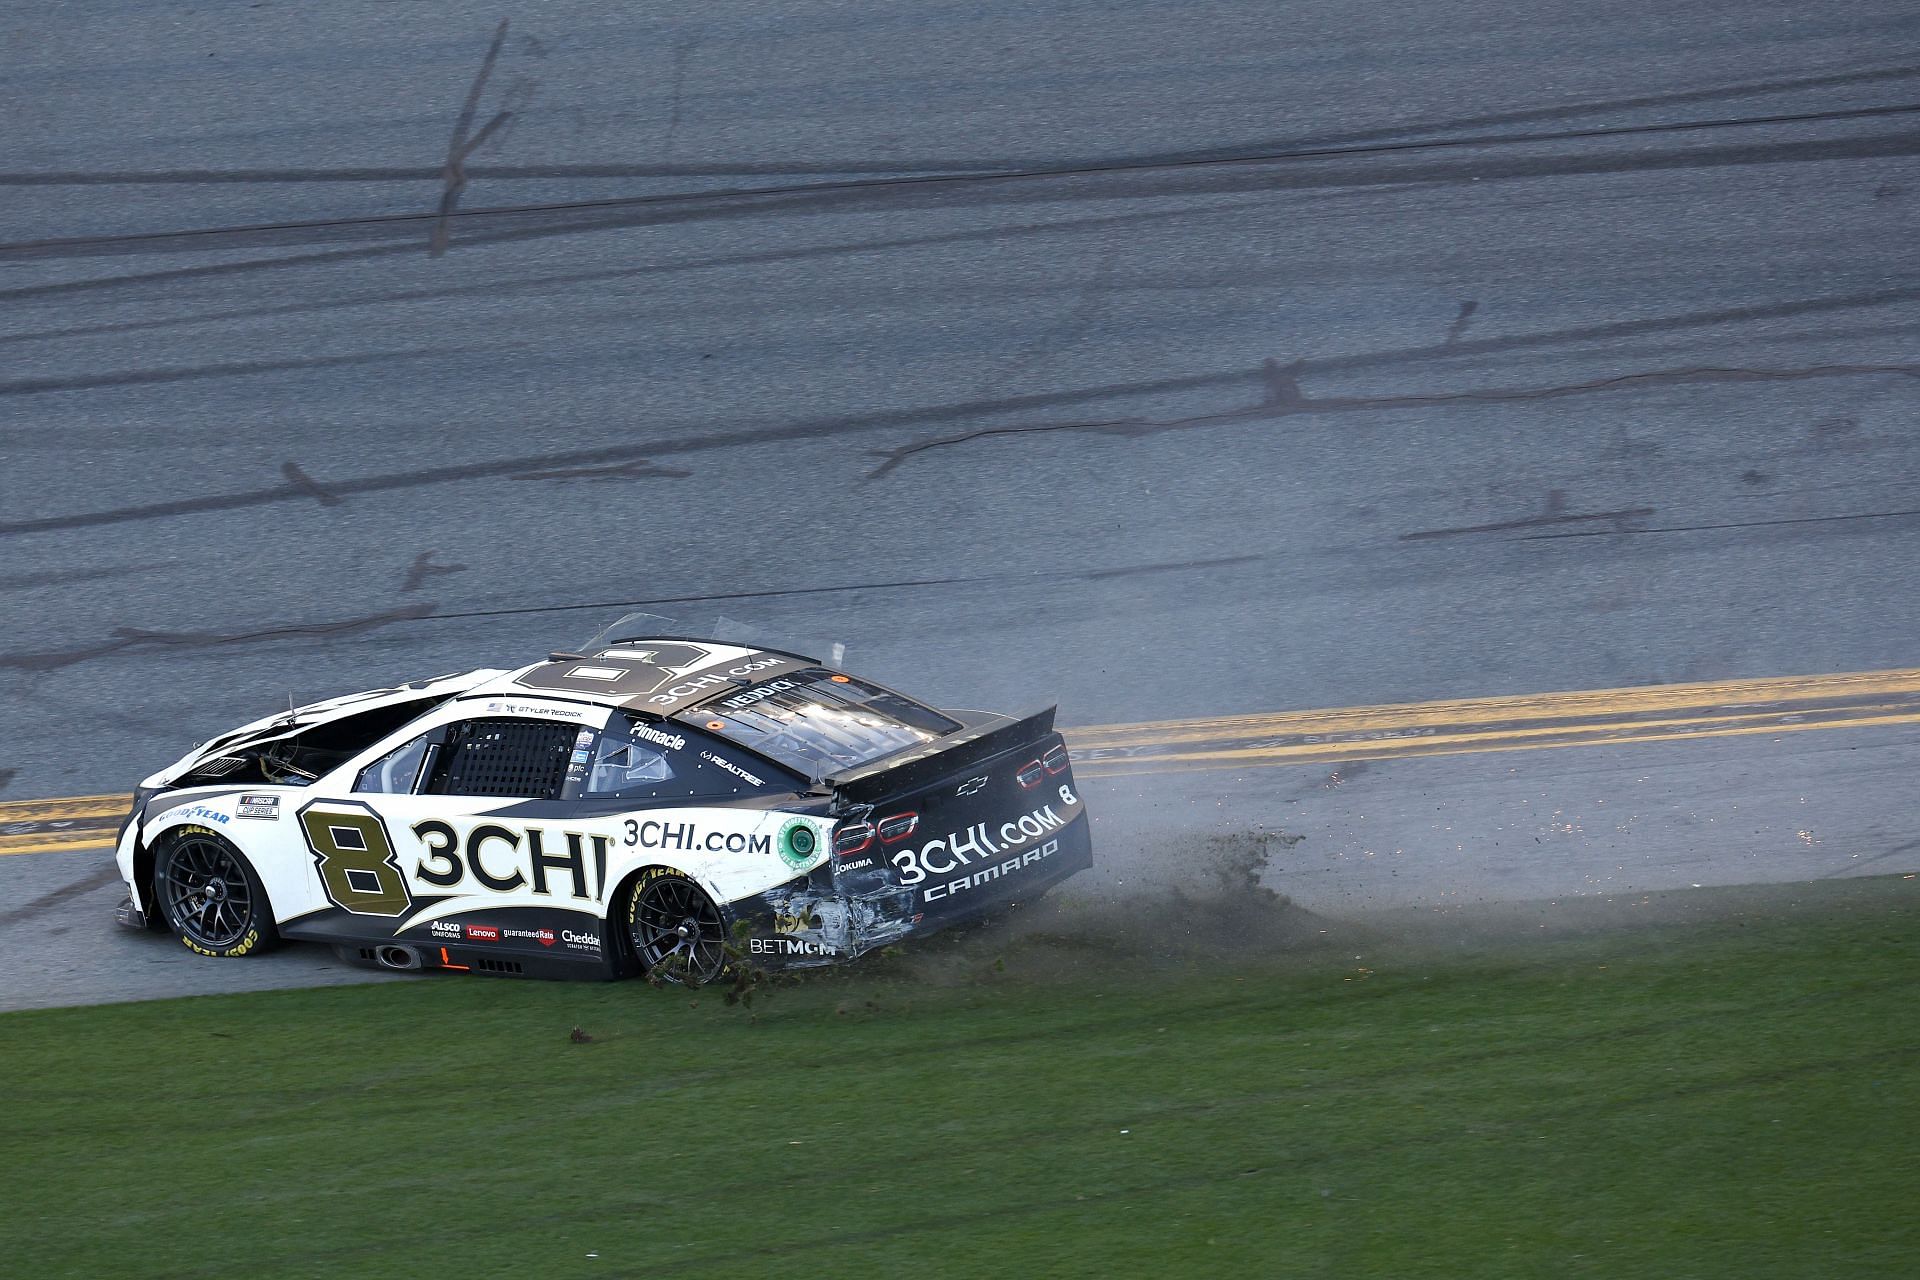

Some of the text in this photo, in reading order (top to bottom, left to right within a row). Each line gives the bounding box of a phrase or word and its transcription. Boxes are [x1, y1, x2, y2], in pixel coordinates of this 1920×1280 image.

[648, 658, 786, 705] 3CHICOM
[629, 720, 686, 751] Pinnacle
[710, 755, 764, 787] REALTREE
[250, 797, 274, 805] NASCAR
[1058, 784, 1077, 805] 8
[159, 806, 230, 825] GOODYEAR
[254, 807, 273, 815] SERIES
[623, 818, 771, 855] 3CHI.COM
[891, 804, 1065, 886] 3CHI.COM
[296, 797, 412, 918] 8
[839, 858, 873, 872] OKUMA
[923, 838, 1058, 903] CAMARO
[431, 930, 461, 939] UNIFORMS
[469, 928, 496, 938] Lenovo
[750, 938, 836, 956] BETMGM
